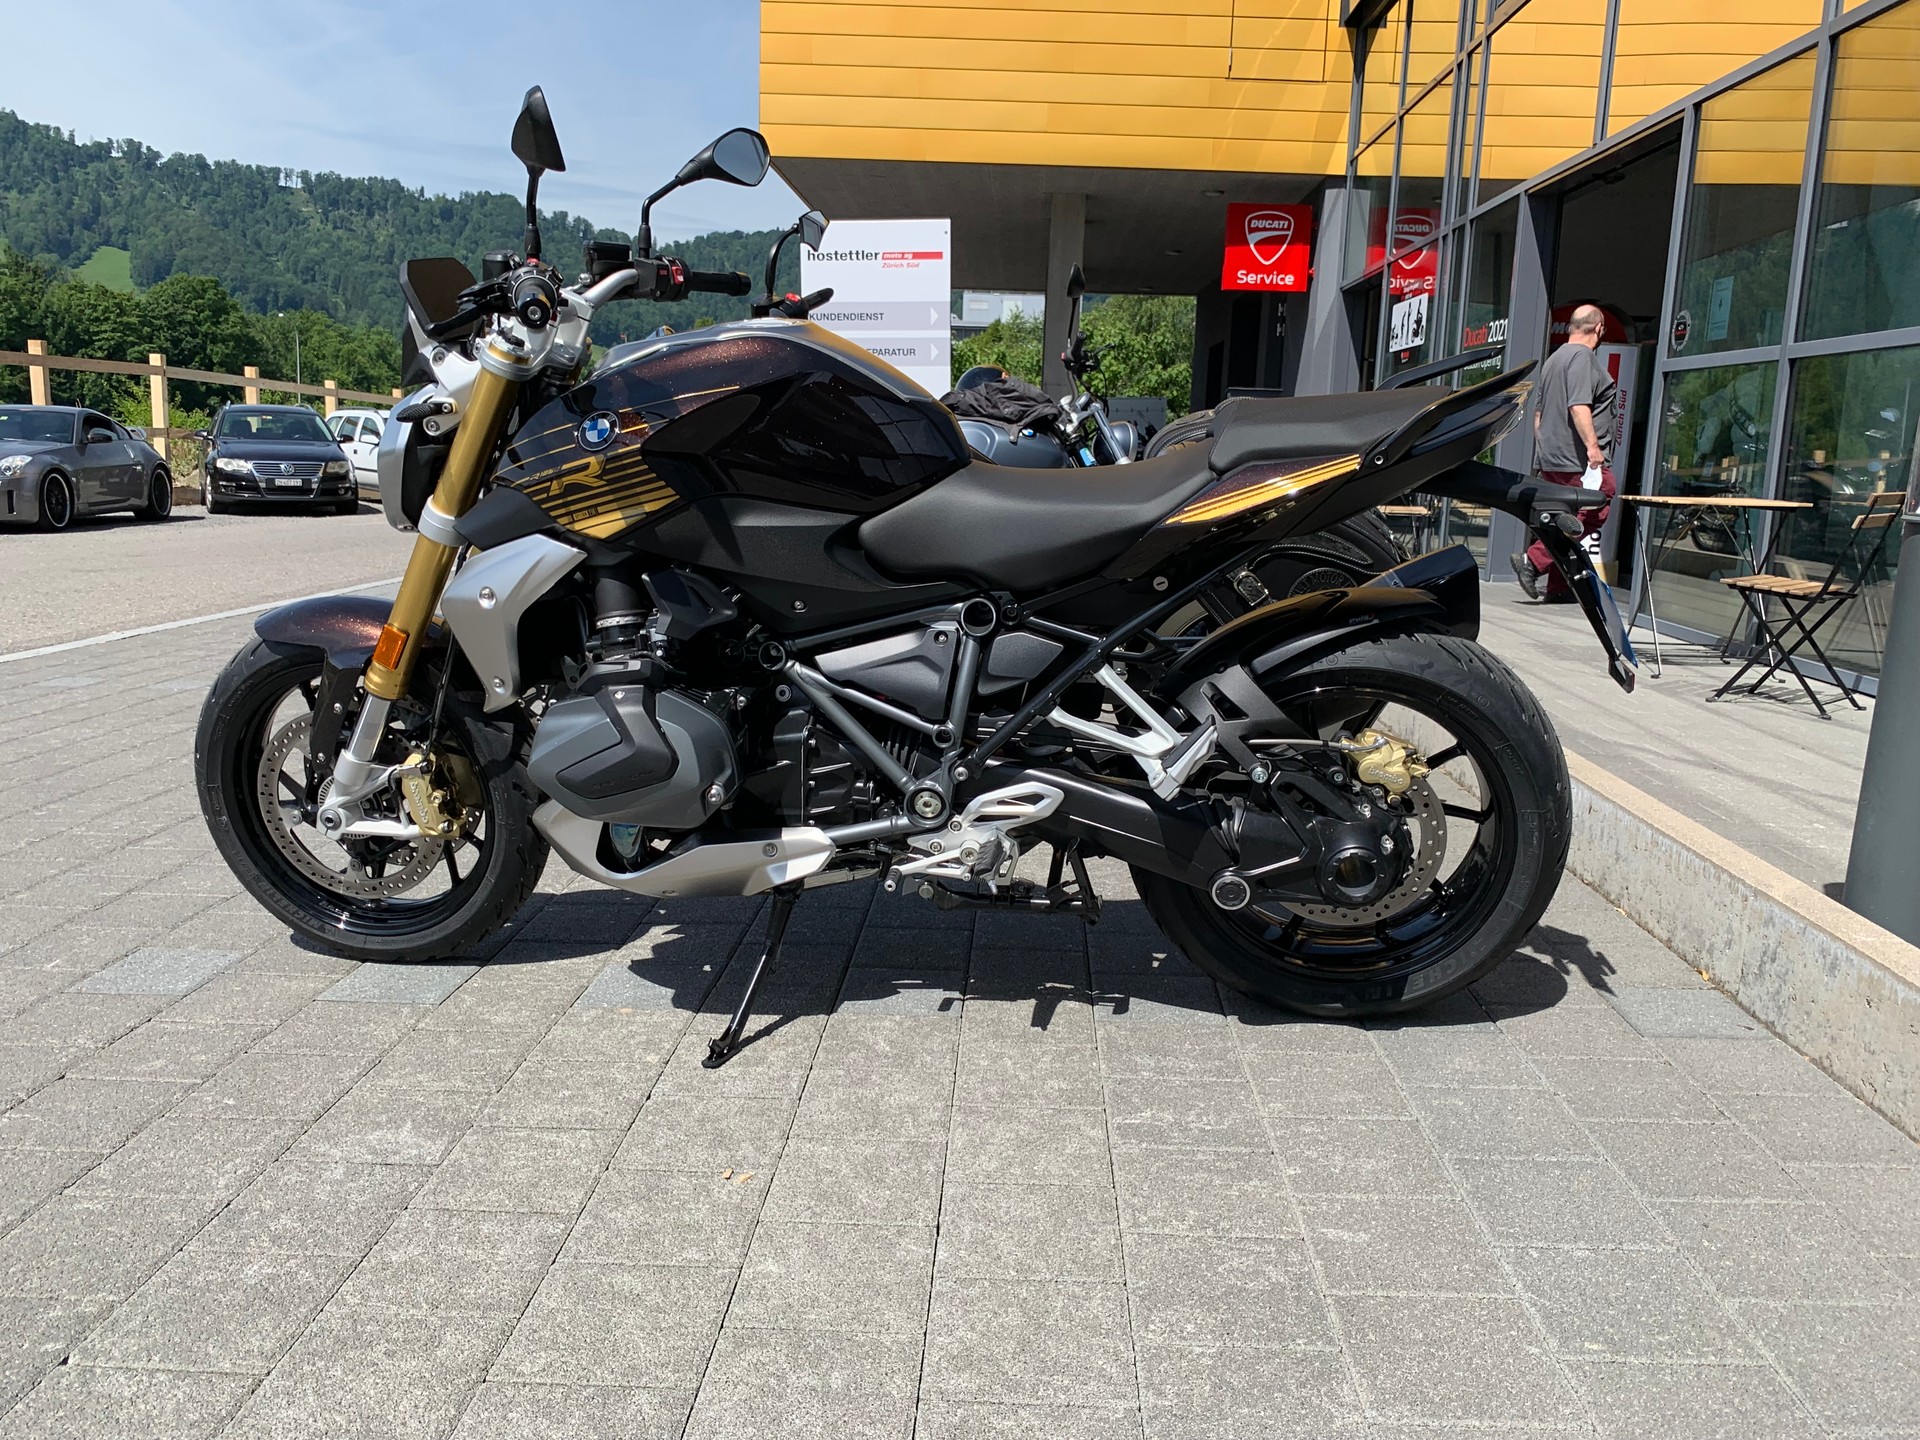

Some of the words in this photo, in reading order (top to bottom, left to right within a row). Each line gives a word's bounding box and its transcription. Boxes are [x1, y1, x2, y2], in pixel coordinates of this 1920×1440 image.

[1250, 219, 1289, 229] DUCATI
[807, 250, 880, 261] hostettler
[1236, 270, 1295, 286] Service
[809, 313, 885, 321] KUNDENDIENST
[1463, 323, 1489, 347] Ducati
[1488, 318, 1509, 343] 2021
[866, 348, 916, 357] PARATUR
[1618, 389, 1628, 411] Süd
